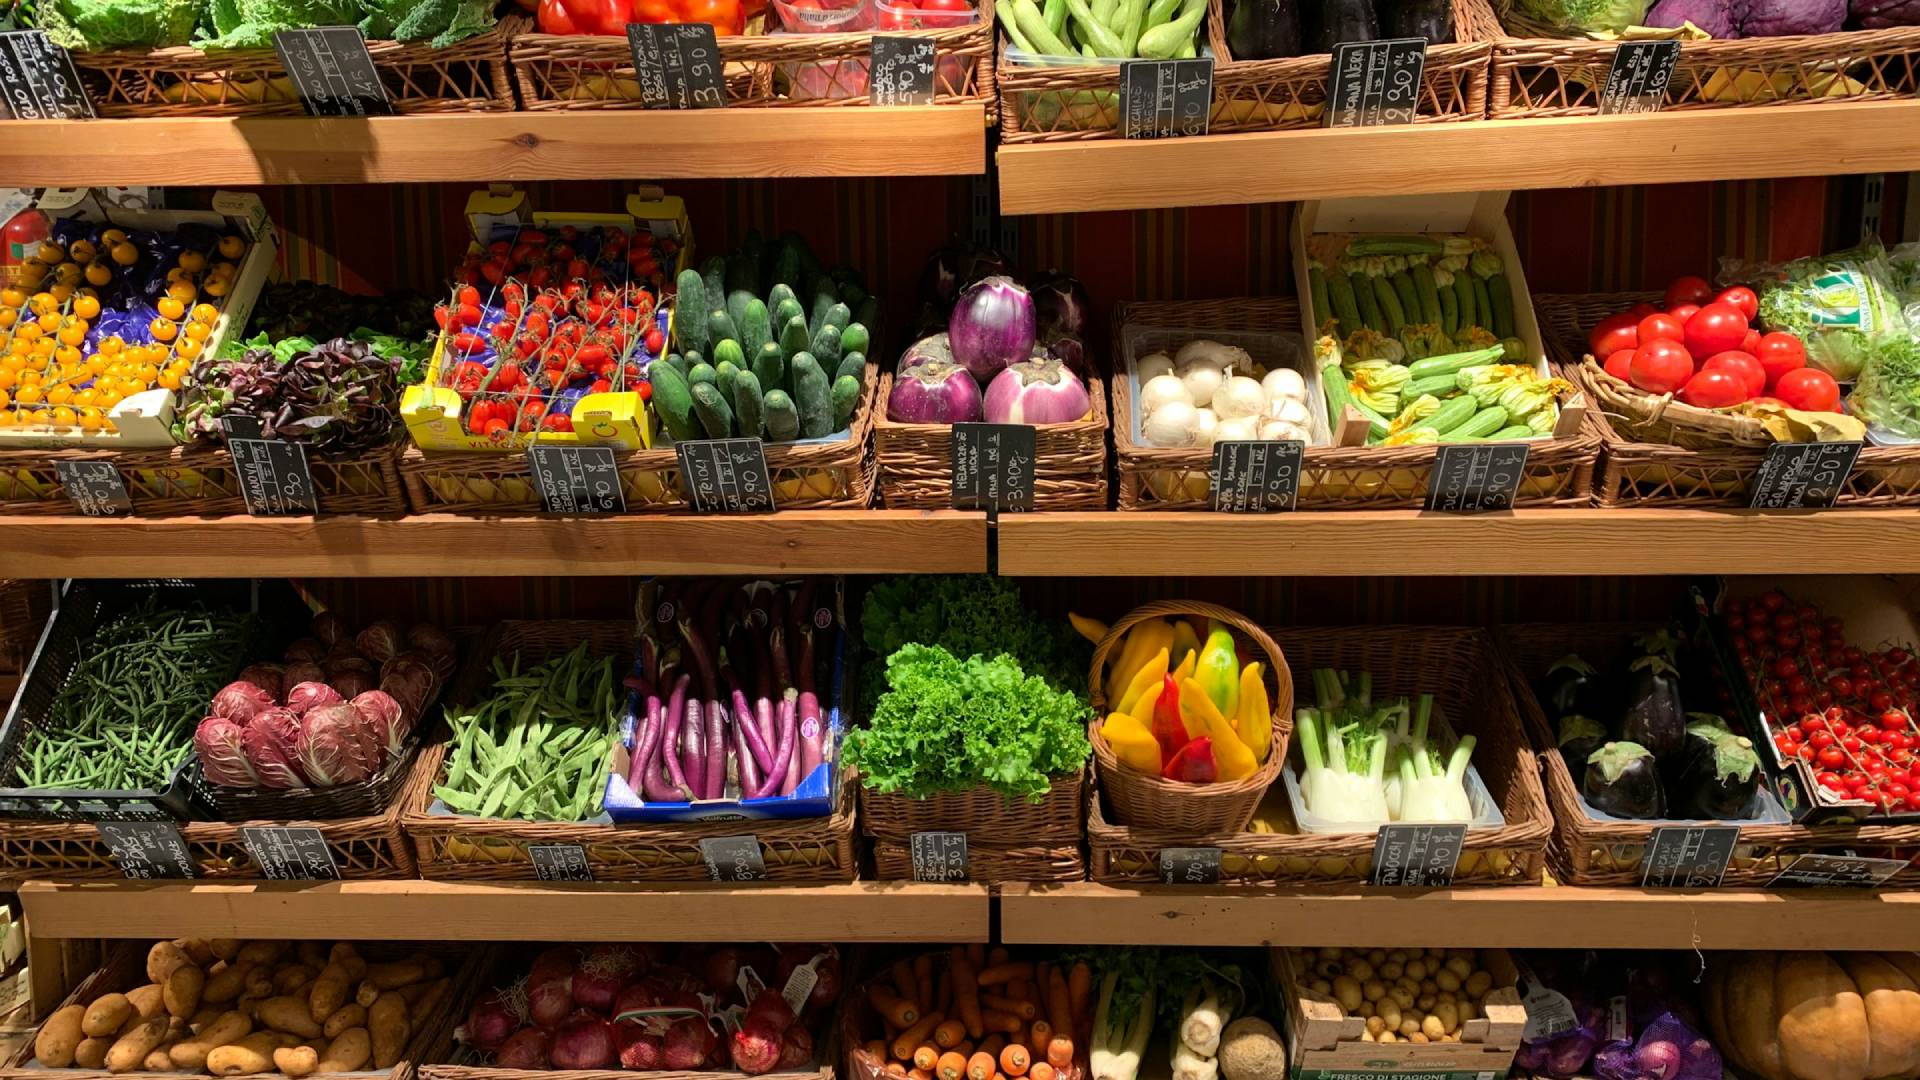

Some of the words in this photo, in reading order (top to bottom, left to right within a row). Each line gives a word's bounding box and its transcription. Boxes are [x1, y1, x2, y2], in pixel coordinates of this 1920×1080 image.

[1343, 49, 1364, 79] NERA
[742, 471, 768, 506] 2,90
[1267, 465, 1292, 507] 2,90
